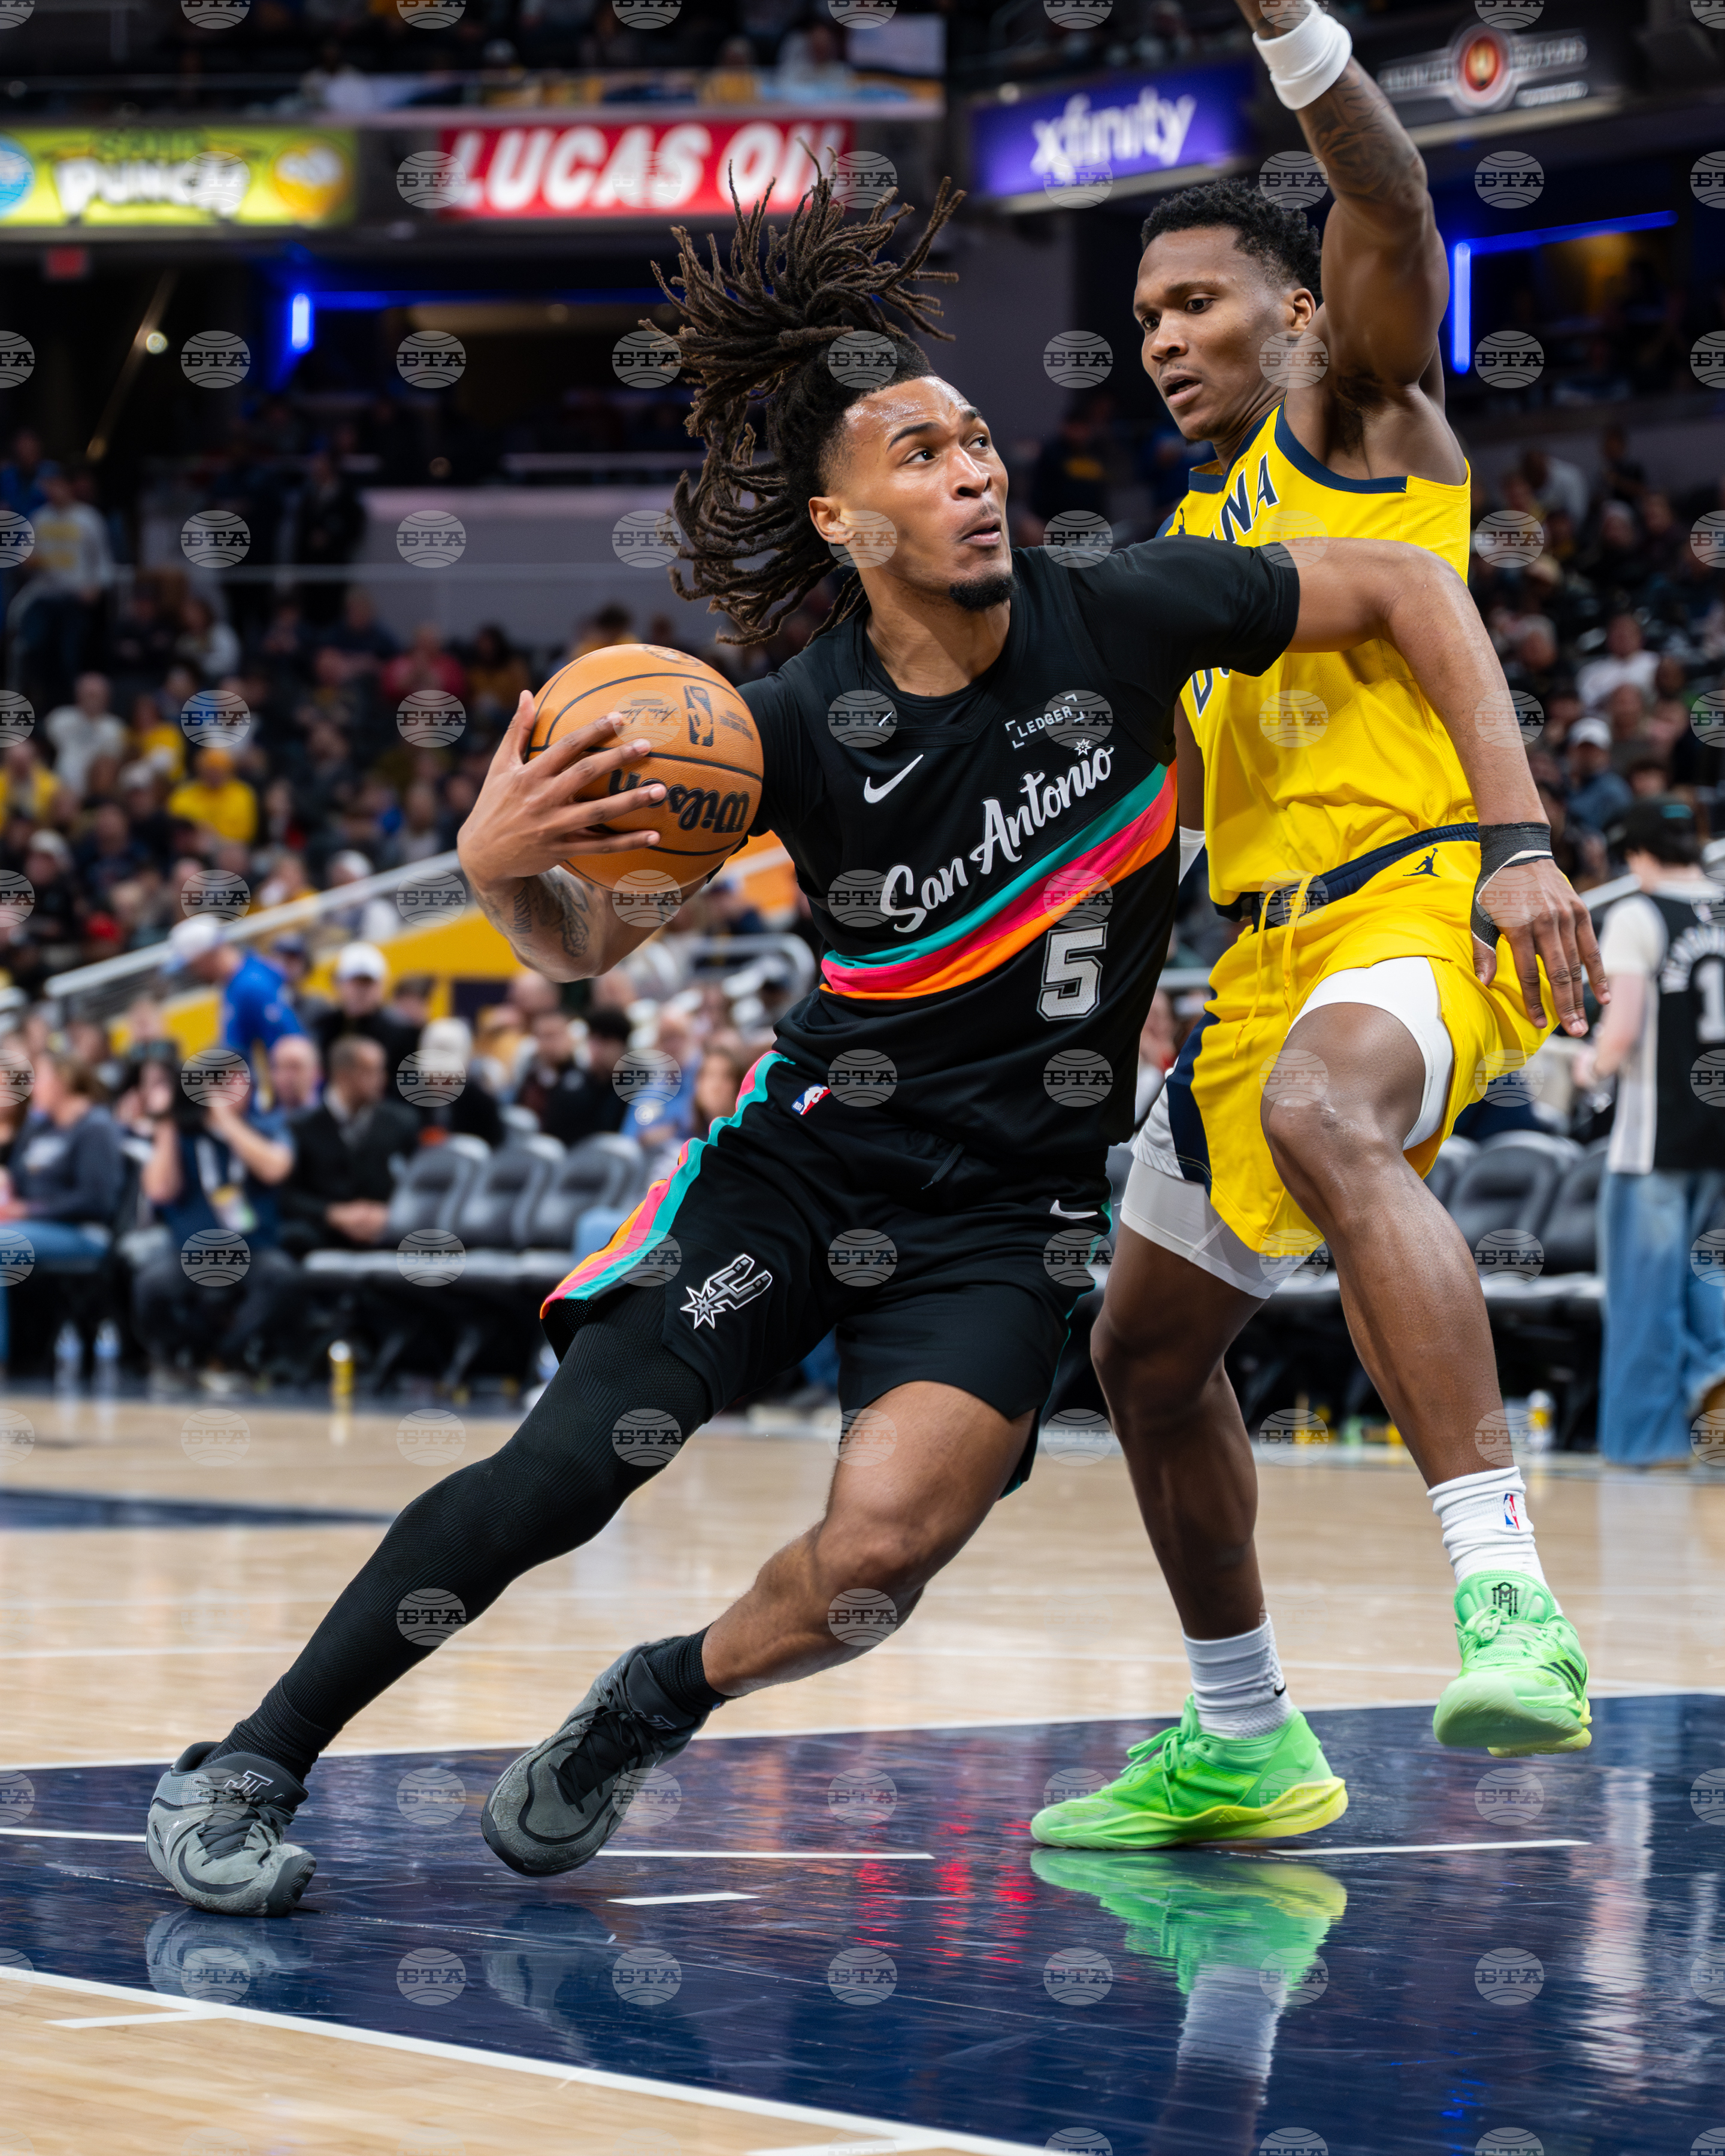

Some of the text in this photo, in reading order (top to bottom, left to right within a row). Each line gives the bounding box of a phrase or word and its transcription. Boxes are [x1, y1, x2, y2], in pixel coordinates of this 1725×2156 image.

[453, 123, 712, 211] LUCAS
[1030, 86, 1197, 183] xfinity
[1016, 705, 1073, 738] LEDGER
[880, 746, 1115, 933] San Antonio
[1036, 922, 1109, 1022] 5
[792, 1101, 804, 1112] NBA
